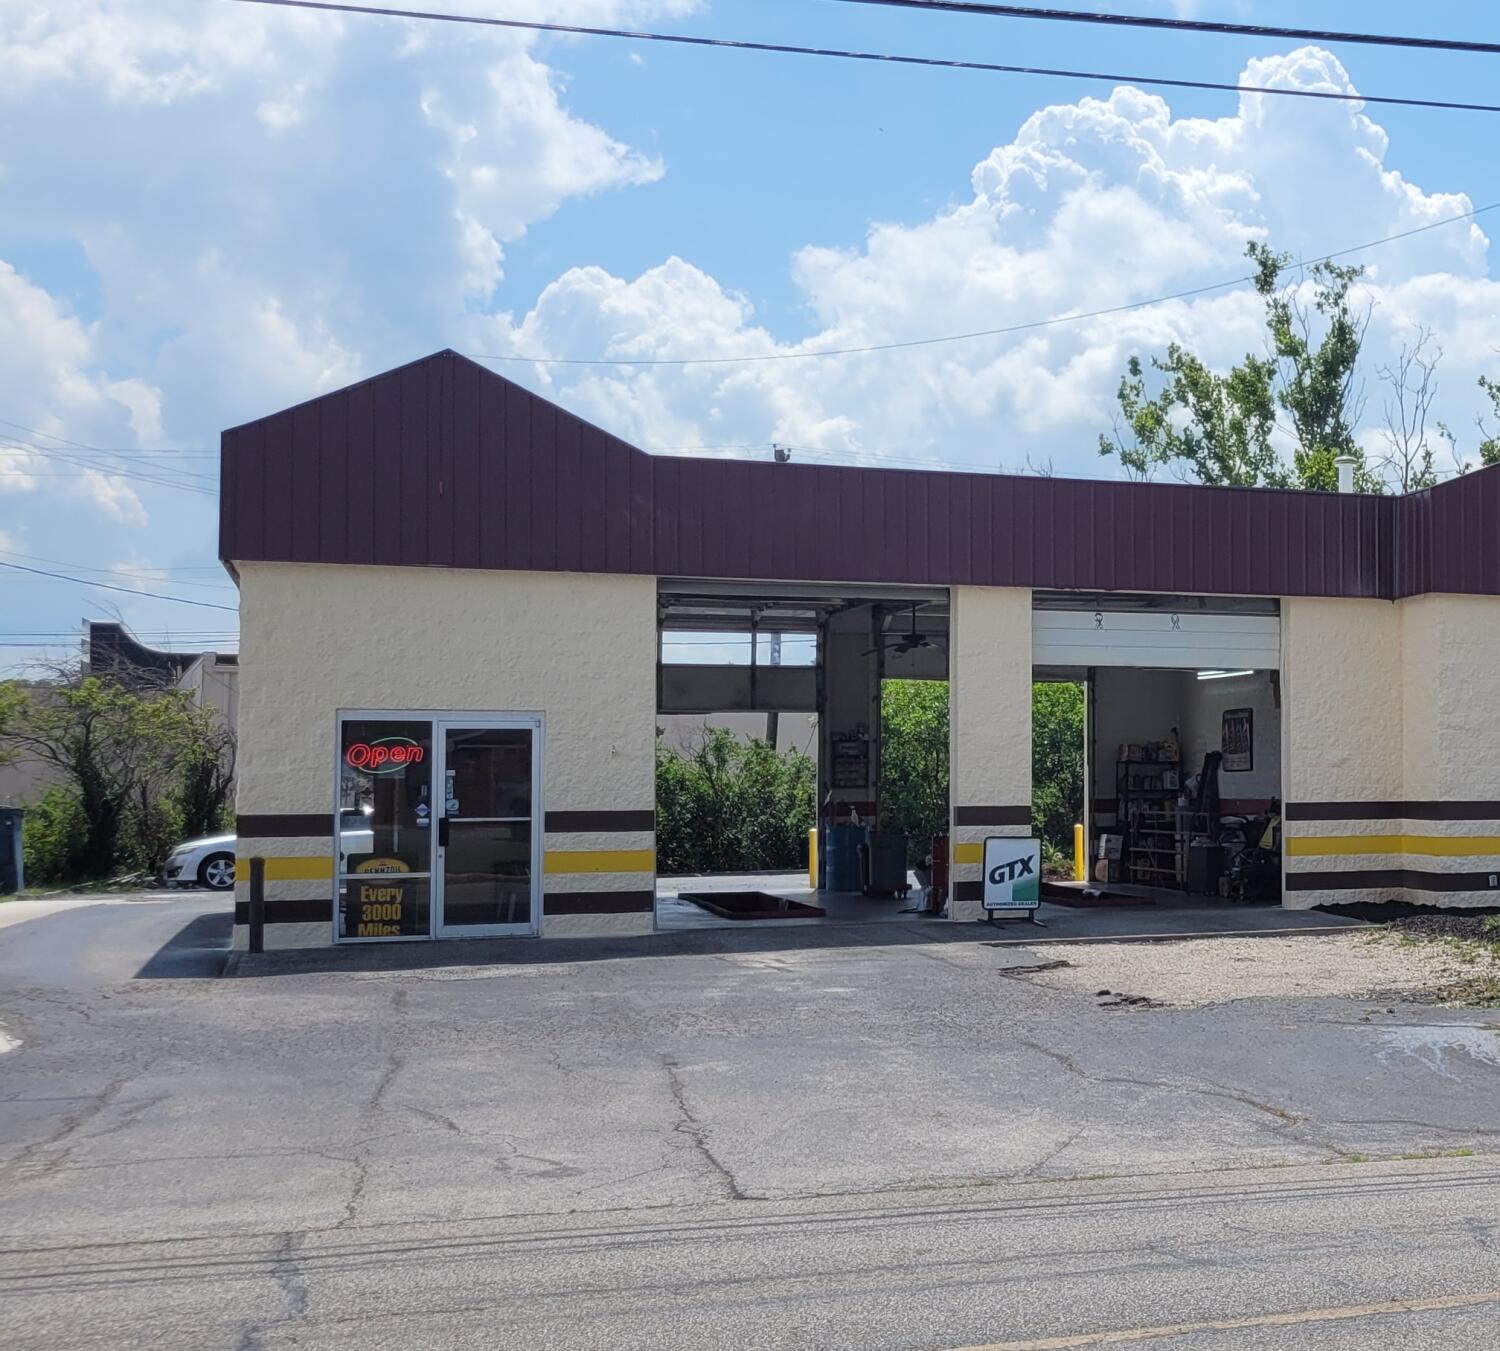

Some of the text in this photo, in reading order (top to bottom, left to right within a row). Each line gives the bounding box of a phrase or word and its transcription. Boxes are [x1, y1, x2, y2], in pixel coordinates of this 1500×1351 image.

[347, 744, 423, 767] Open
[988, 854, 1035, 885] GTX
[360, 886, 403, 903] Every
[362, 904, 401, 920] 3000
[357, 923, 400, 937] Miles
